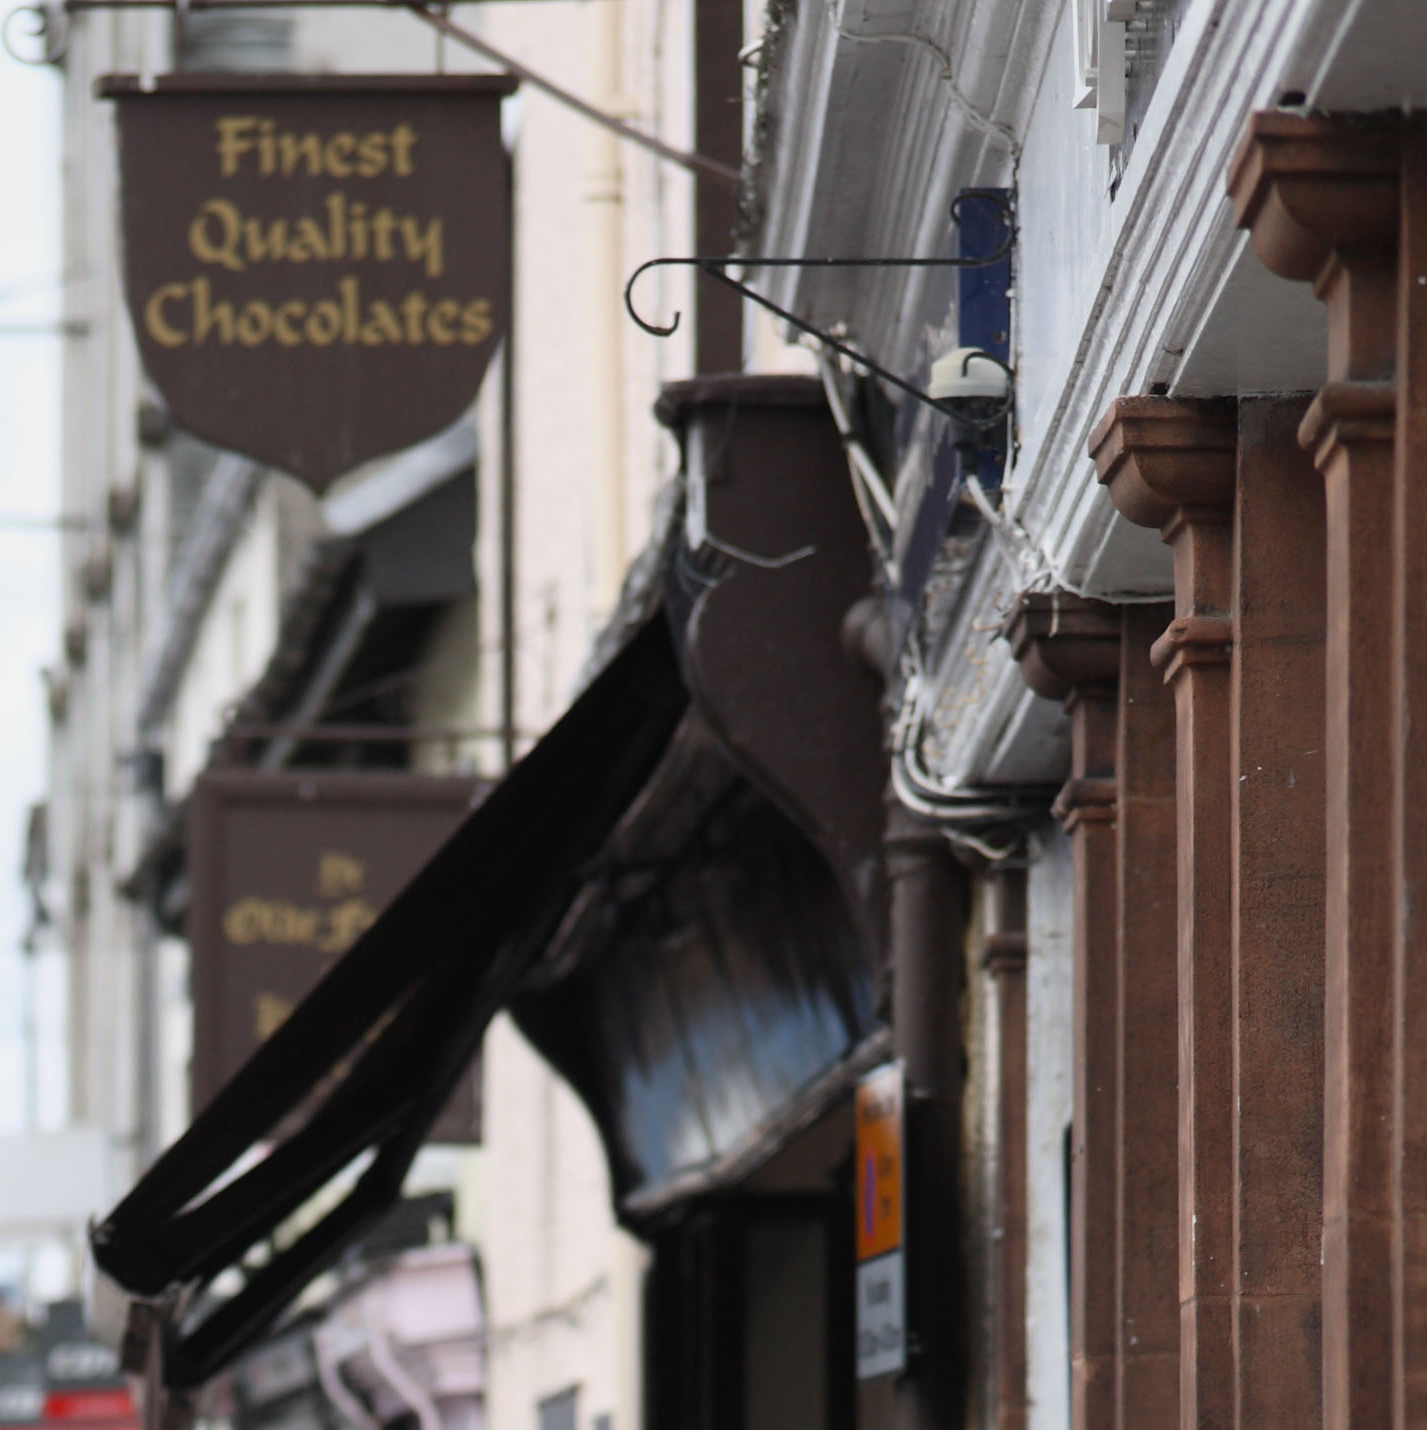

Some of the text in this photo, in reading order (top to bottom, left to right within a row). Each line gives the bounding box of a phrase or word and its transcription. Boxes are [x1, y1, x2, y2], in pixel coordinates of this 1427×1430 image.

[217, 116, 419, 179] Finest
[187, 190, 444, 278] Quality
[144, 275, 494, 348] Chocolates
